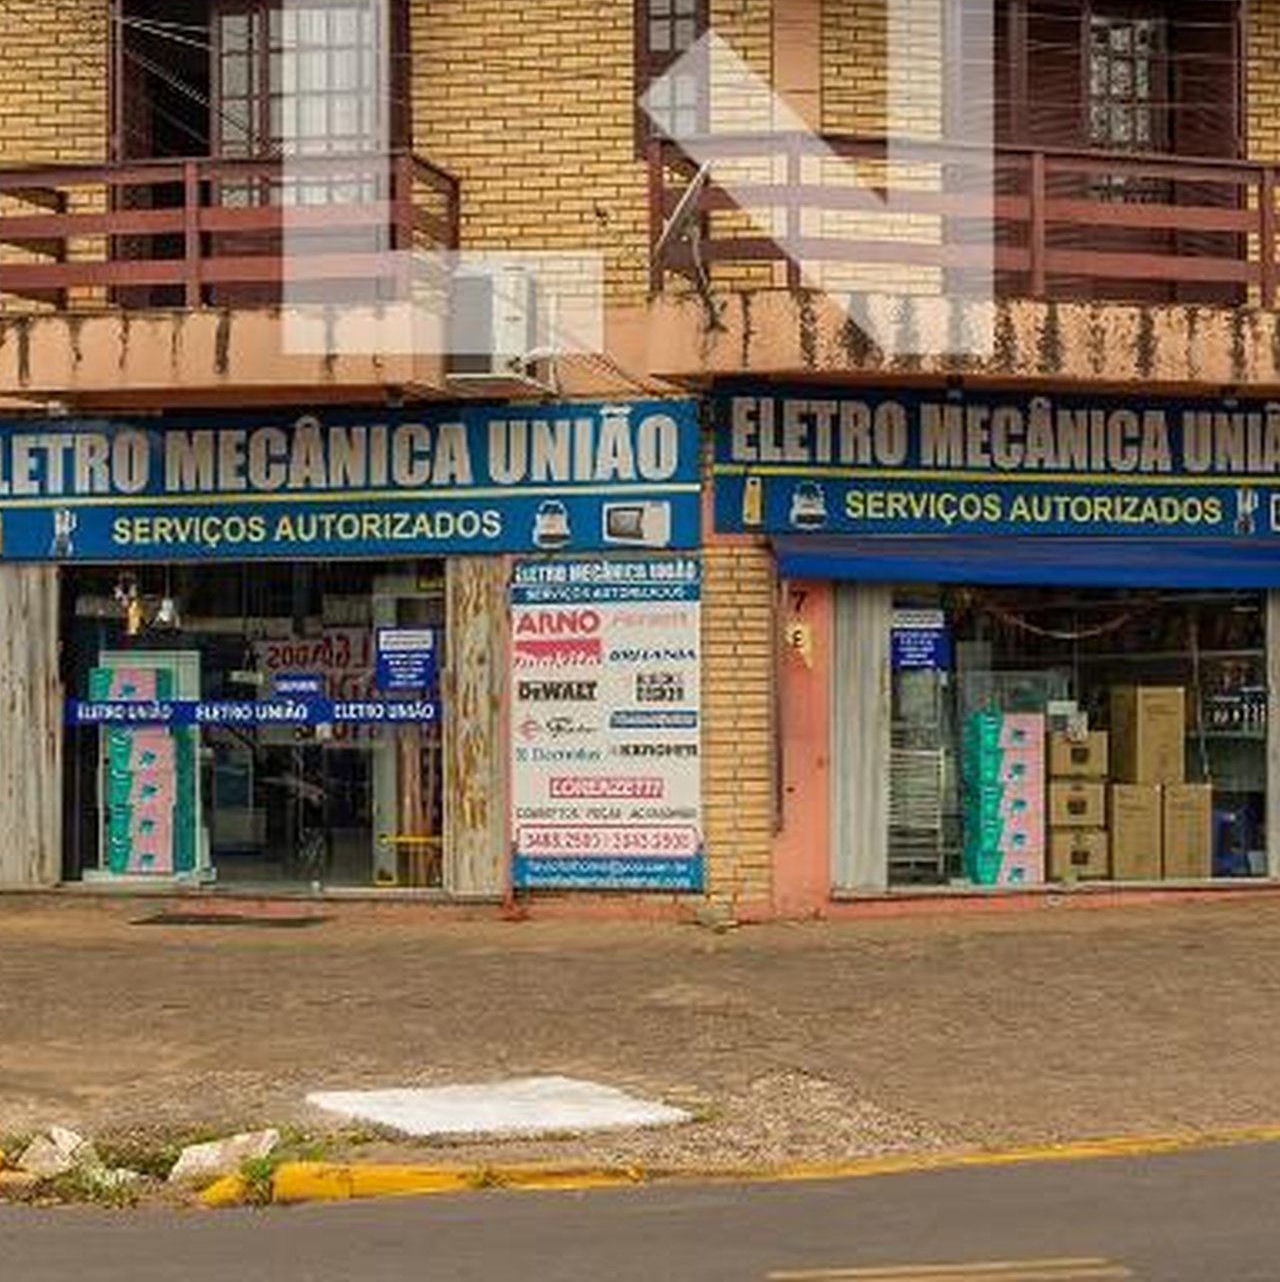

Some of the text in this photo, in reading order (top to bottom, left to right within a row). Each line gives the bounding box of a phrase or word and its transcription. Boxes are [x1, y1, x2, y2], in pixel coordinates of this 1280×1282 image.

[731, 396, 908, 465] ELETRO
[920, 397, 1171, 472] MECÂNICA
[163, 416, 473, 494] MECÂNICA
[489, 405, 679, 485] UNIÃO
[845, 490, 1222, 524] SERVIÇOS AUTORIZADOS
[112, 509, 502, 549] SERVIÇOS AUTORIZADOS
[516, 564, 567, 583] ELETRO
[792, 590, 808, 613] 7
[517, 610, 601, 634] ARNO
[514, 648, 601, 668] makita
[77, 703, 125, 720] ELETRO
[195, 699, 309, 720] ELETRO UNIÃO
[335, 700, 435, 719] ELETRO UNIÃO
